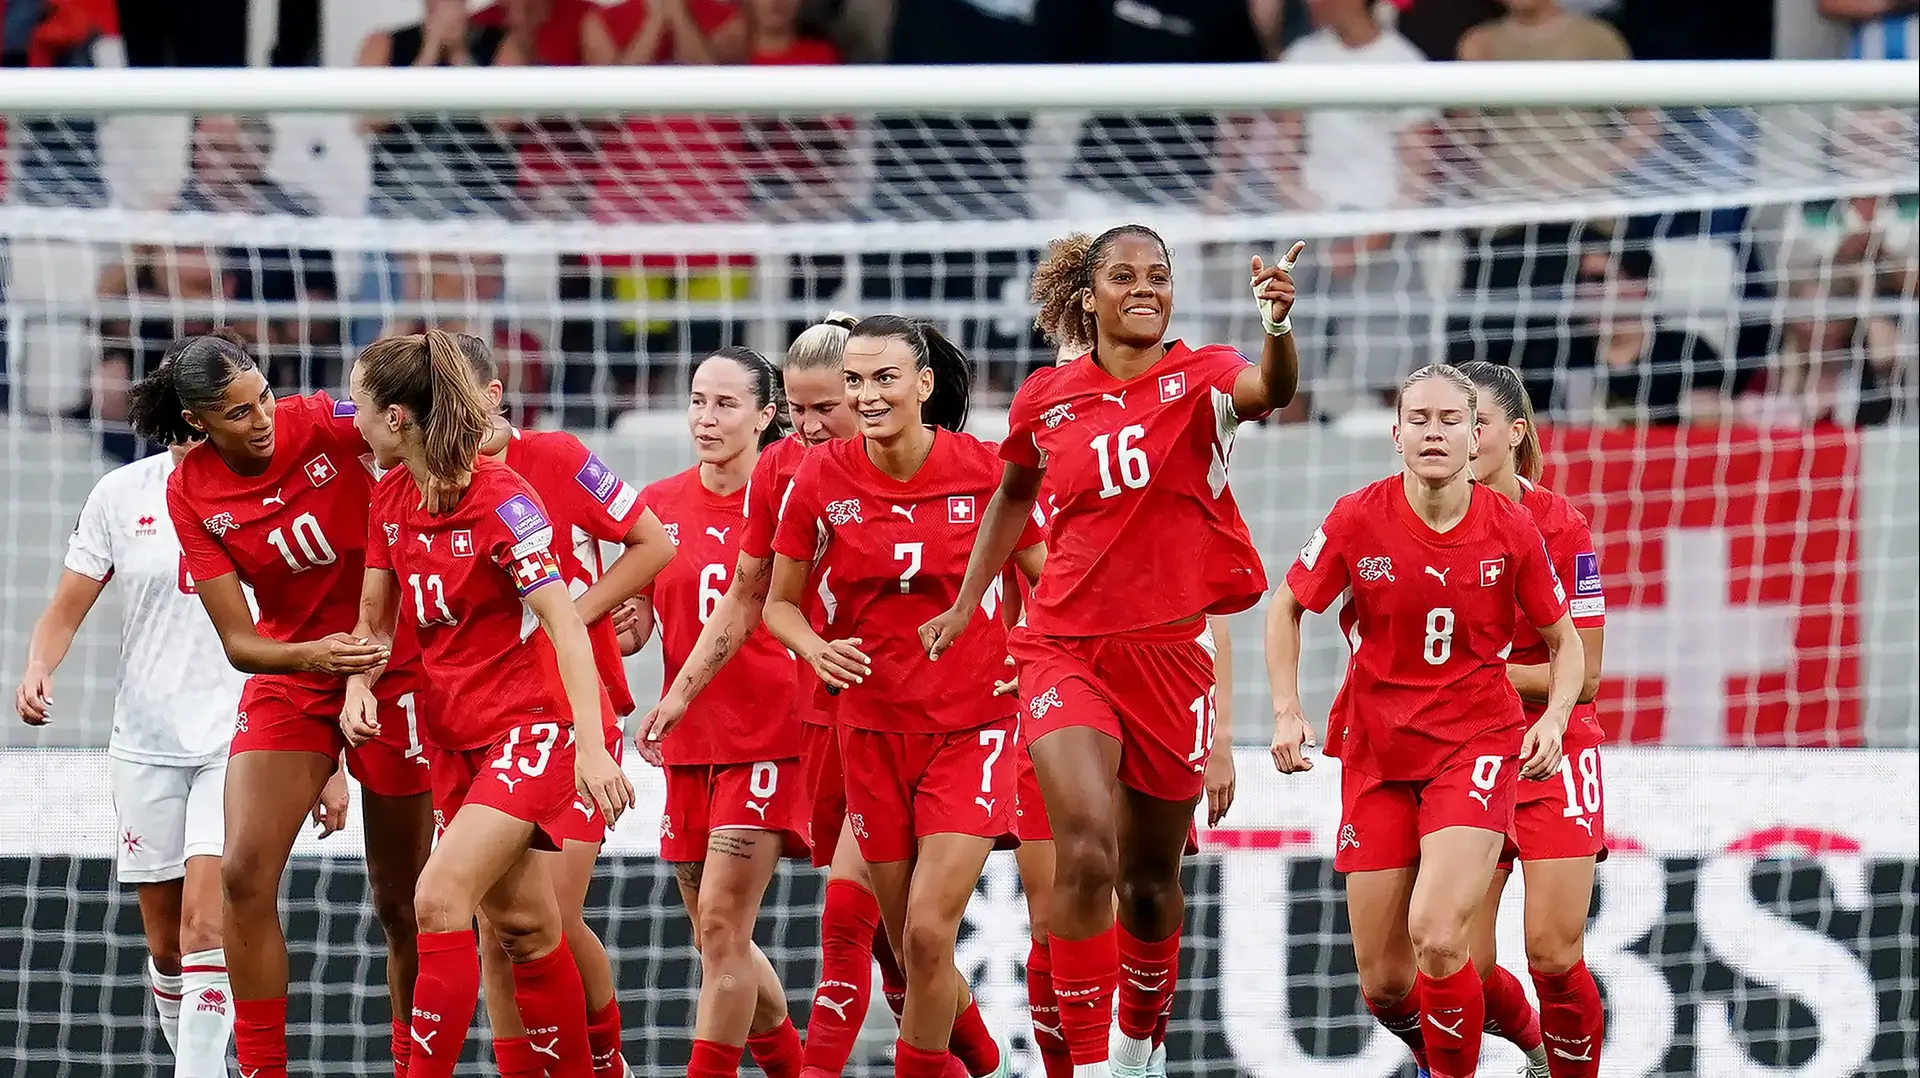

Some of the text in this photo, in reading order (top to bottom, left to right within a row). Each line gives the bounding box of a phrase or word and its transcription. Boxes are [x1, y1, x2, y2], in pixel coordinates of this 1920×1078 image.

[1090, 424, 1151, 498] 16
[266, 511, 337, 571] 10
[894, 542, 924, 594] 7
[698, 563, 727, 626] 6
[1424, 607, 1455, 665] 8
[490, 722, 560, 778] 13
[979, 729, 1007, 793] 7
[1557, 746, 1601, 818] 18
[1203, 827, 1877, 1078] UBS
